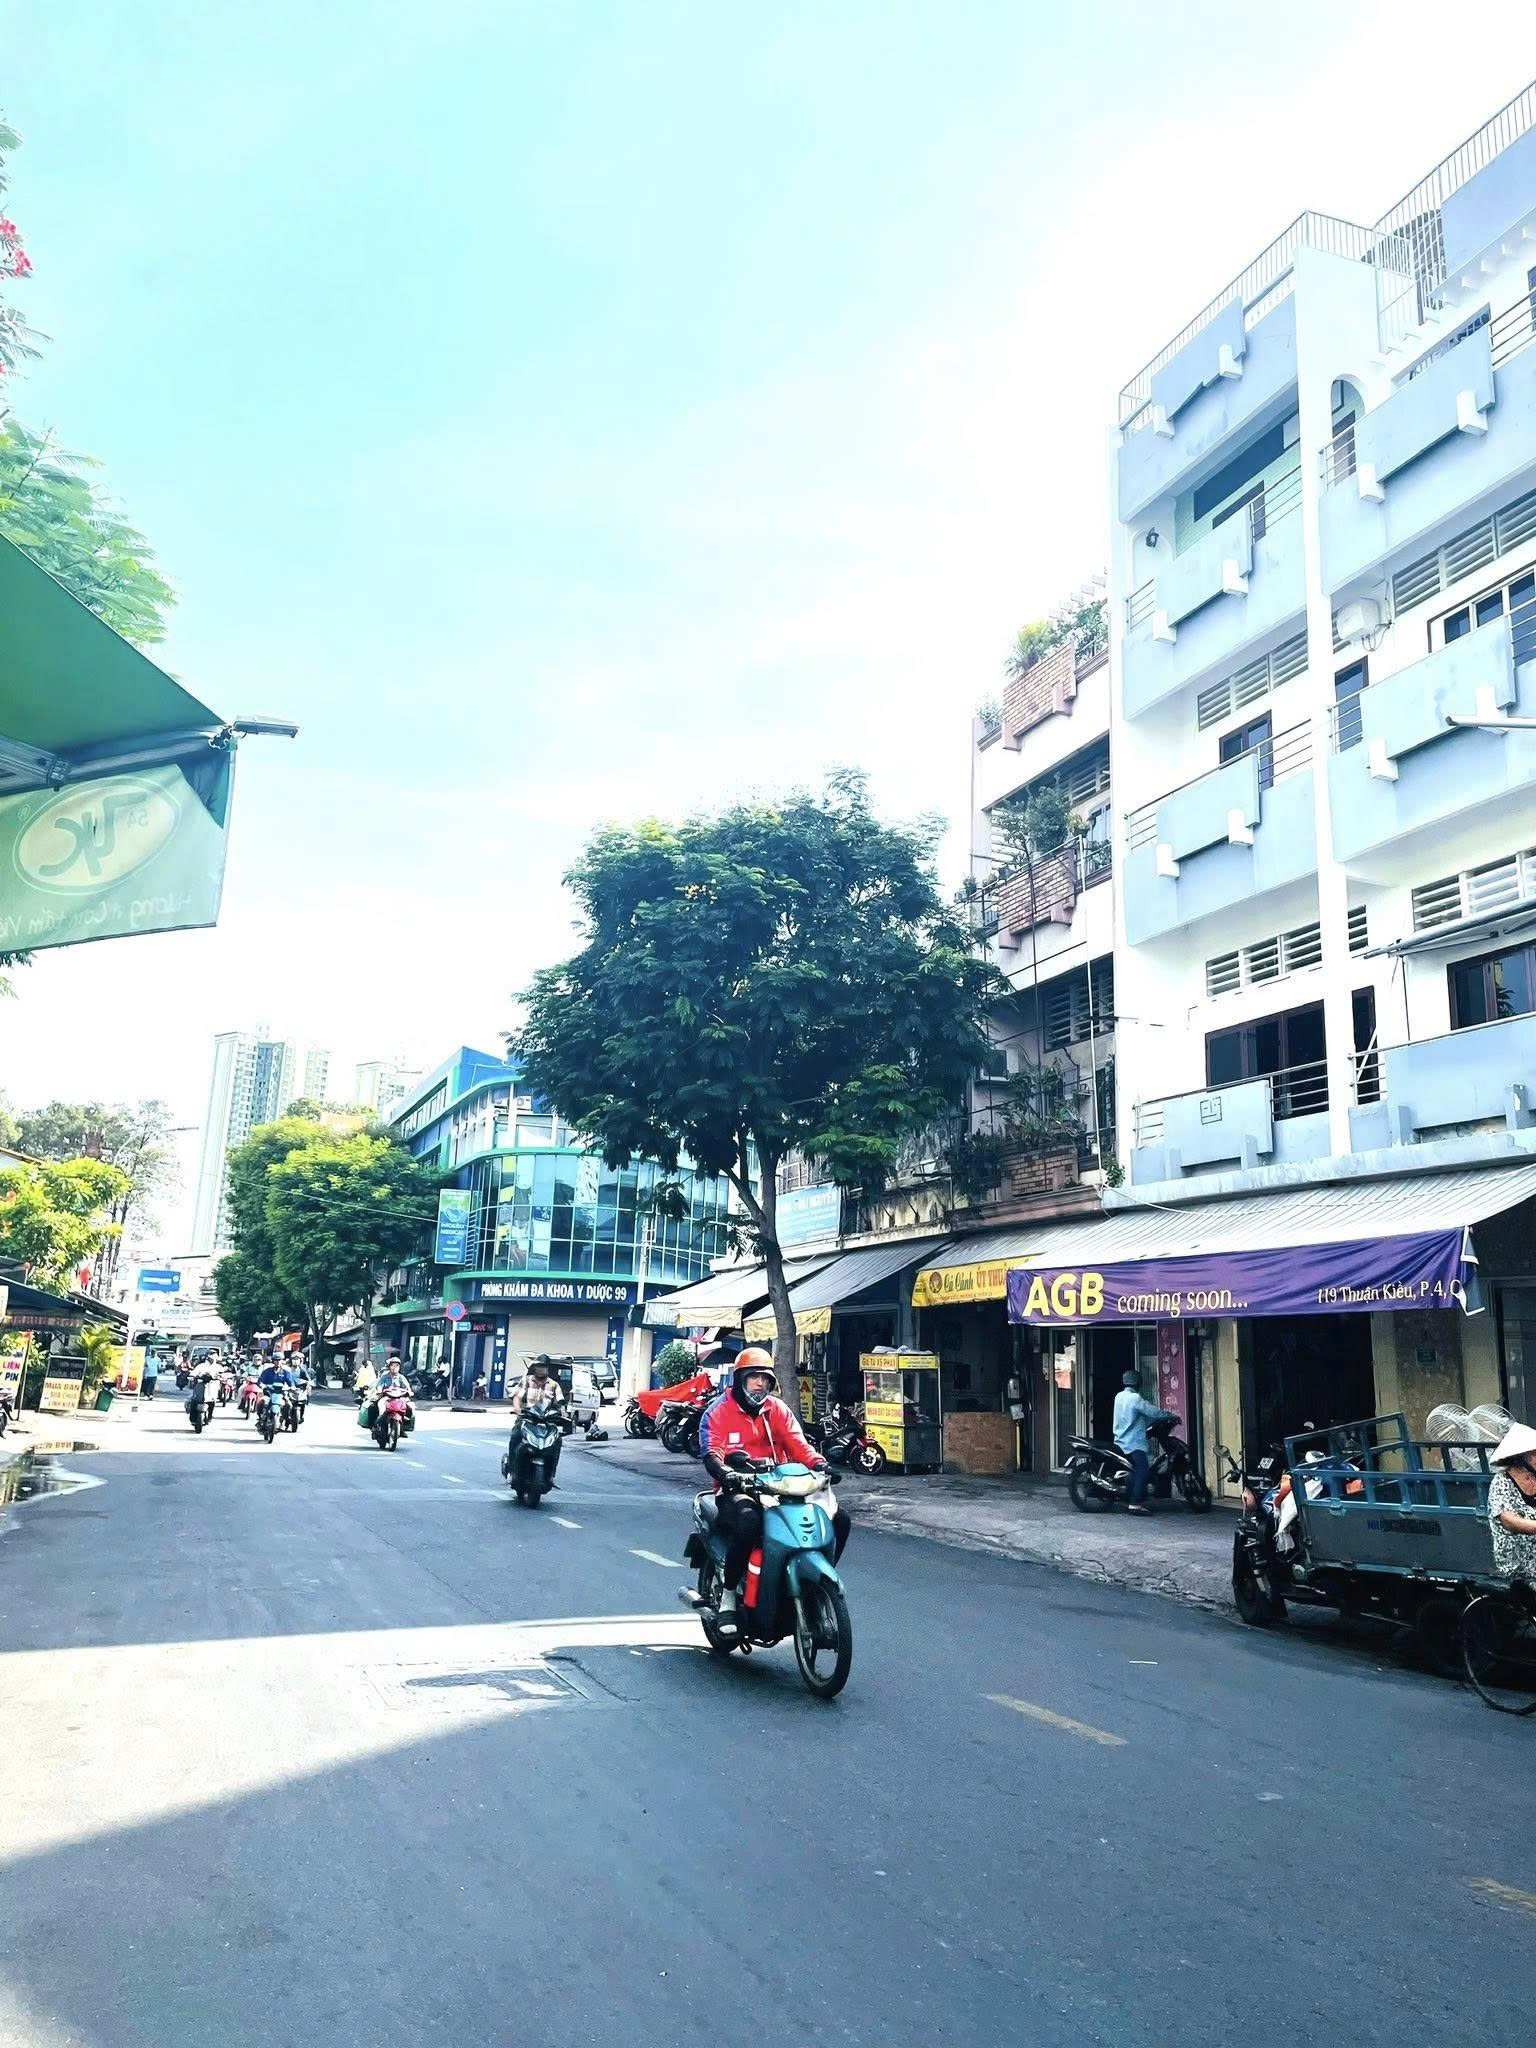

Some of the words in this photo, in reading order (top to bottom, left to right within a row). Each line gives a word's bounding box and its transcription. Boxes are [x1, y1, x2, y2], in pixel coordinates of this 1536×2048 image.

[503, 1281, 529, 1297] KHÁM
[530, 1283, 544, 1297] ĐA
[547, 1284, 574, 1298] KHOA
[577, 1285, 584, 1299] Y
[586, 1283, 613, 1302] DƯỢC
[614, 1287, 627, 1300] 99
[1022, 1272, 1105, 1317] AGB
[1117, 1288, 1181, 1318] coming
[1186, 1289, 1249, 1312] soon...
[1318, 1288, 1337, 1304] 119
[1340, 1286, 1379, 1304] Thuận
[1382, 1281, 1417, 1301] Kiều,
